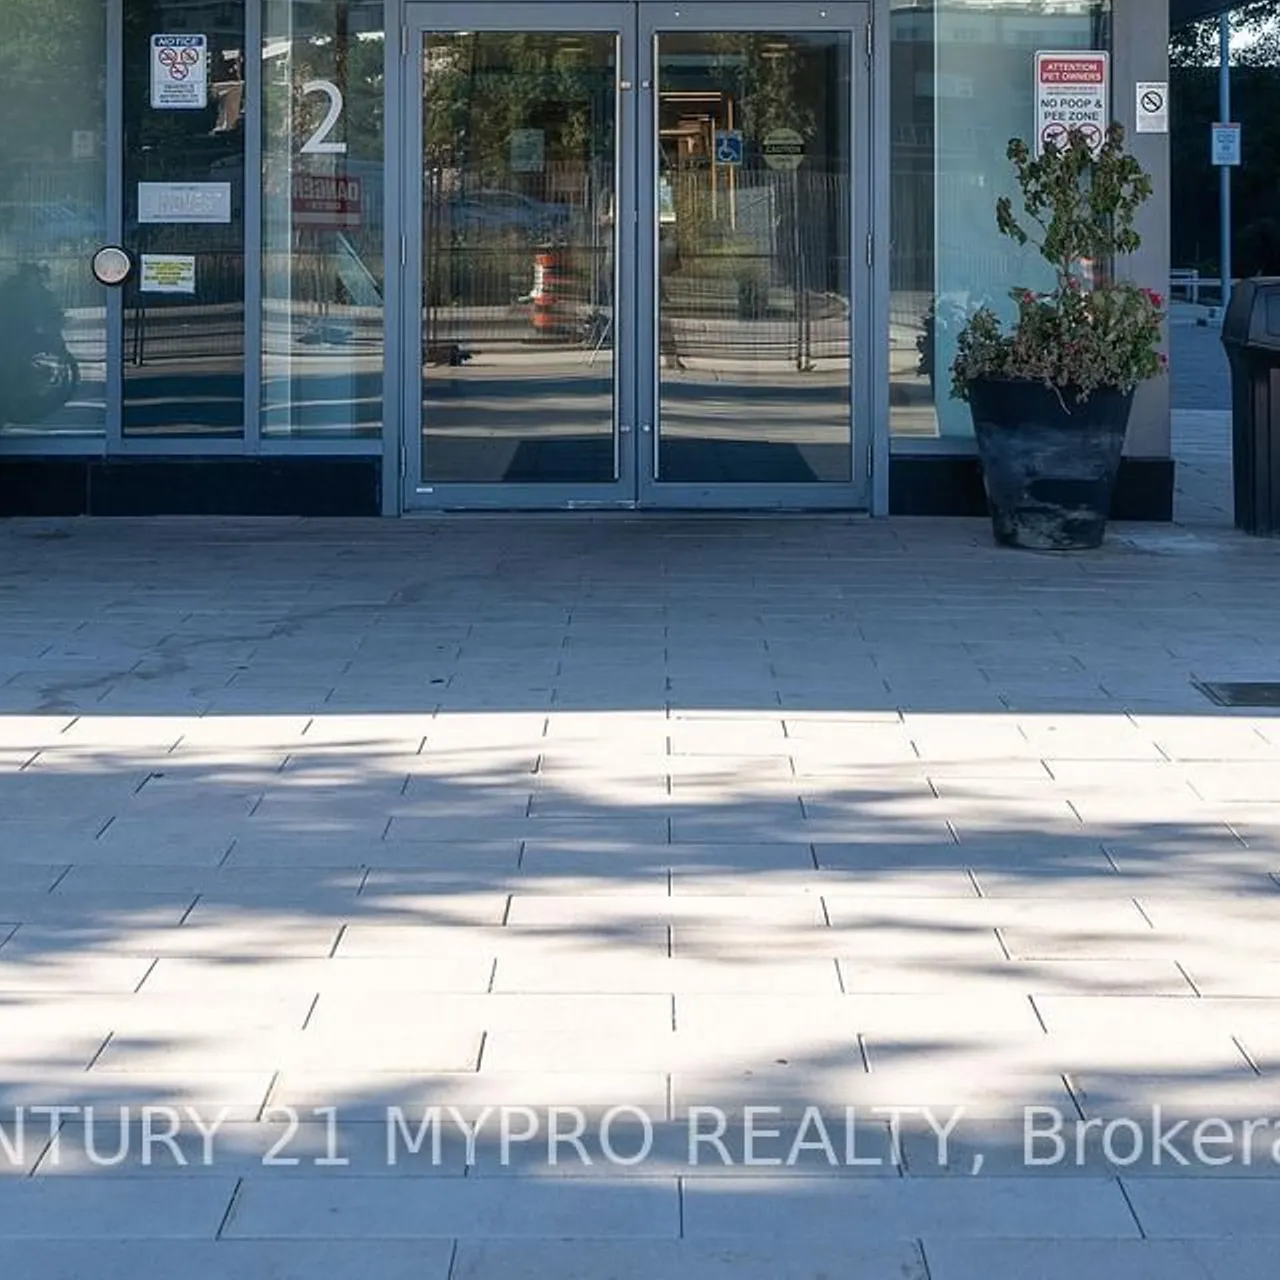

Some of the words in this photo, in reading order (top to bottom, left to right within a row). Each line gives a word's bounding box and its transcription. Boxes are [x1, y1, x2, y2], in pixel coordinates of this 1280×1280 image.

[1047, 63, 1097, 71] ATTENTION
[1042, 72, 1061, 81] PET
[1062, 72, 1101, 81] OWNERS
[1041, 98, 1057, 108] NO
[1060, 98, 1092, 108] POOP
[1094, 99, 1102, 108] &
[299, 80, 347, 154] 2
[1044, 111, 1065, 121] PEE
[1068, 111, 1099, 121] ZONE
